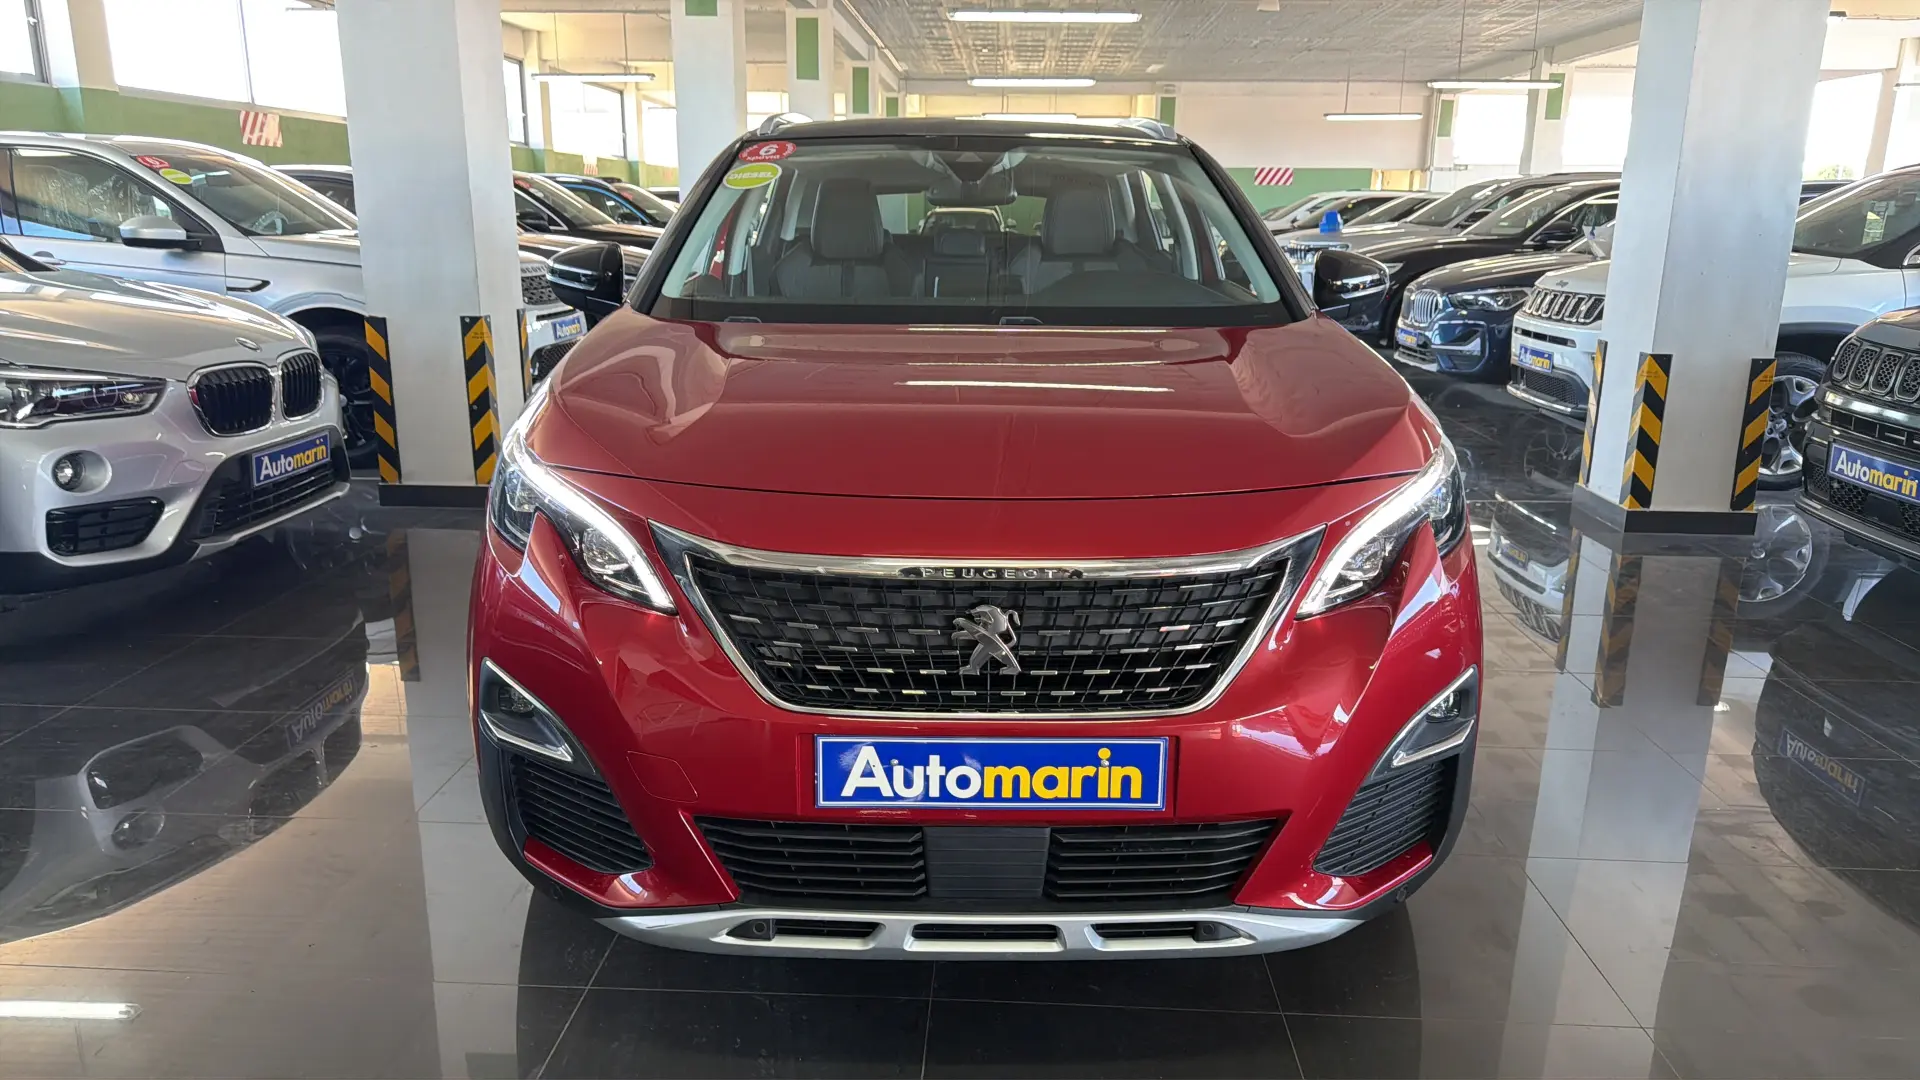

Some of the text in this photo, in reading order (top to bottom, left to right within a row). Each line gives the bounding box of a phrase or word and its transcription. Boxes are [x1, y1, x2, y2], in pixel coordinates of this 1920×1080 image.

[260, 439, 327, 481] Automarin
[1834, 450, 1918, 498] Automarin
[921, 567, 1058, 579] PEUGEOT
[840, 746, 1143, 799] Automarin
